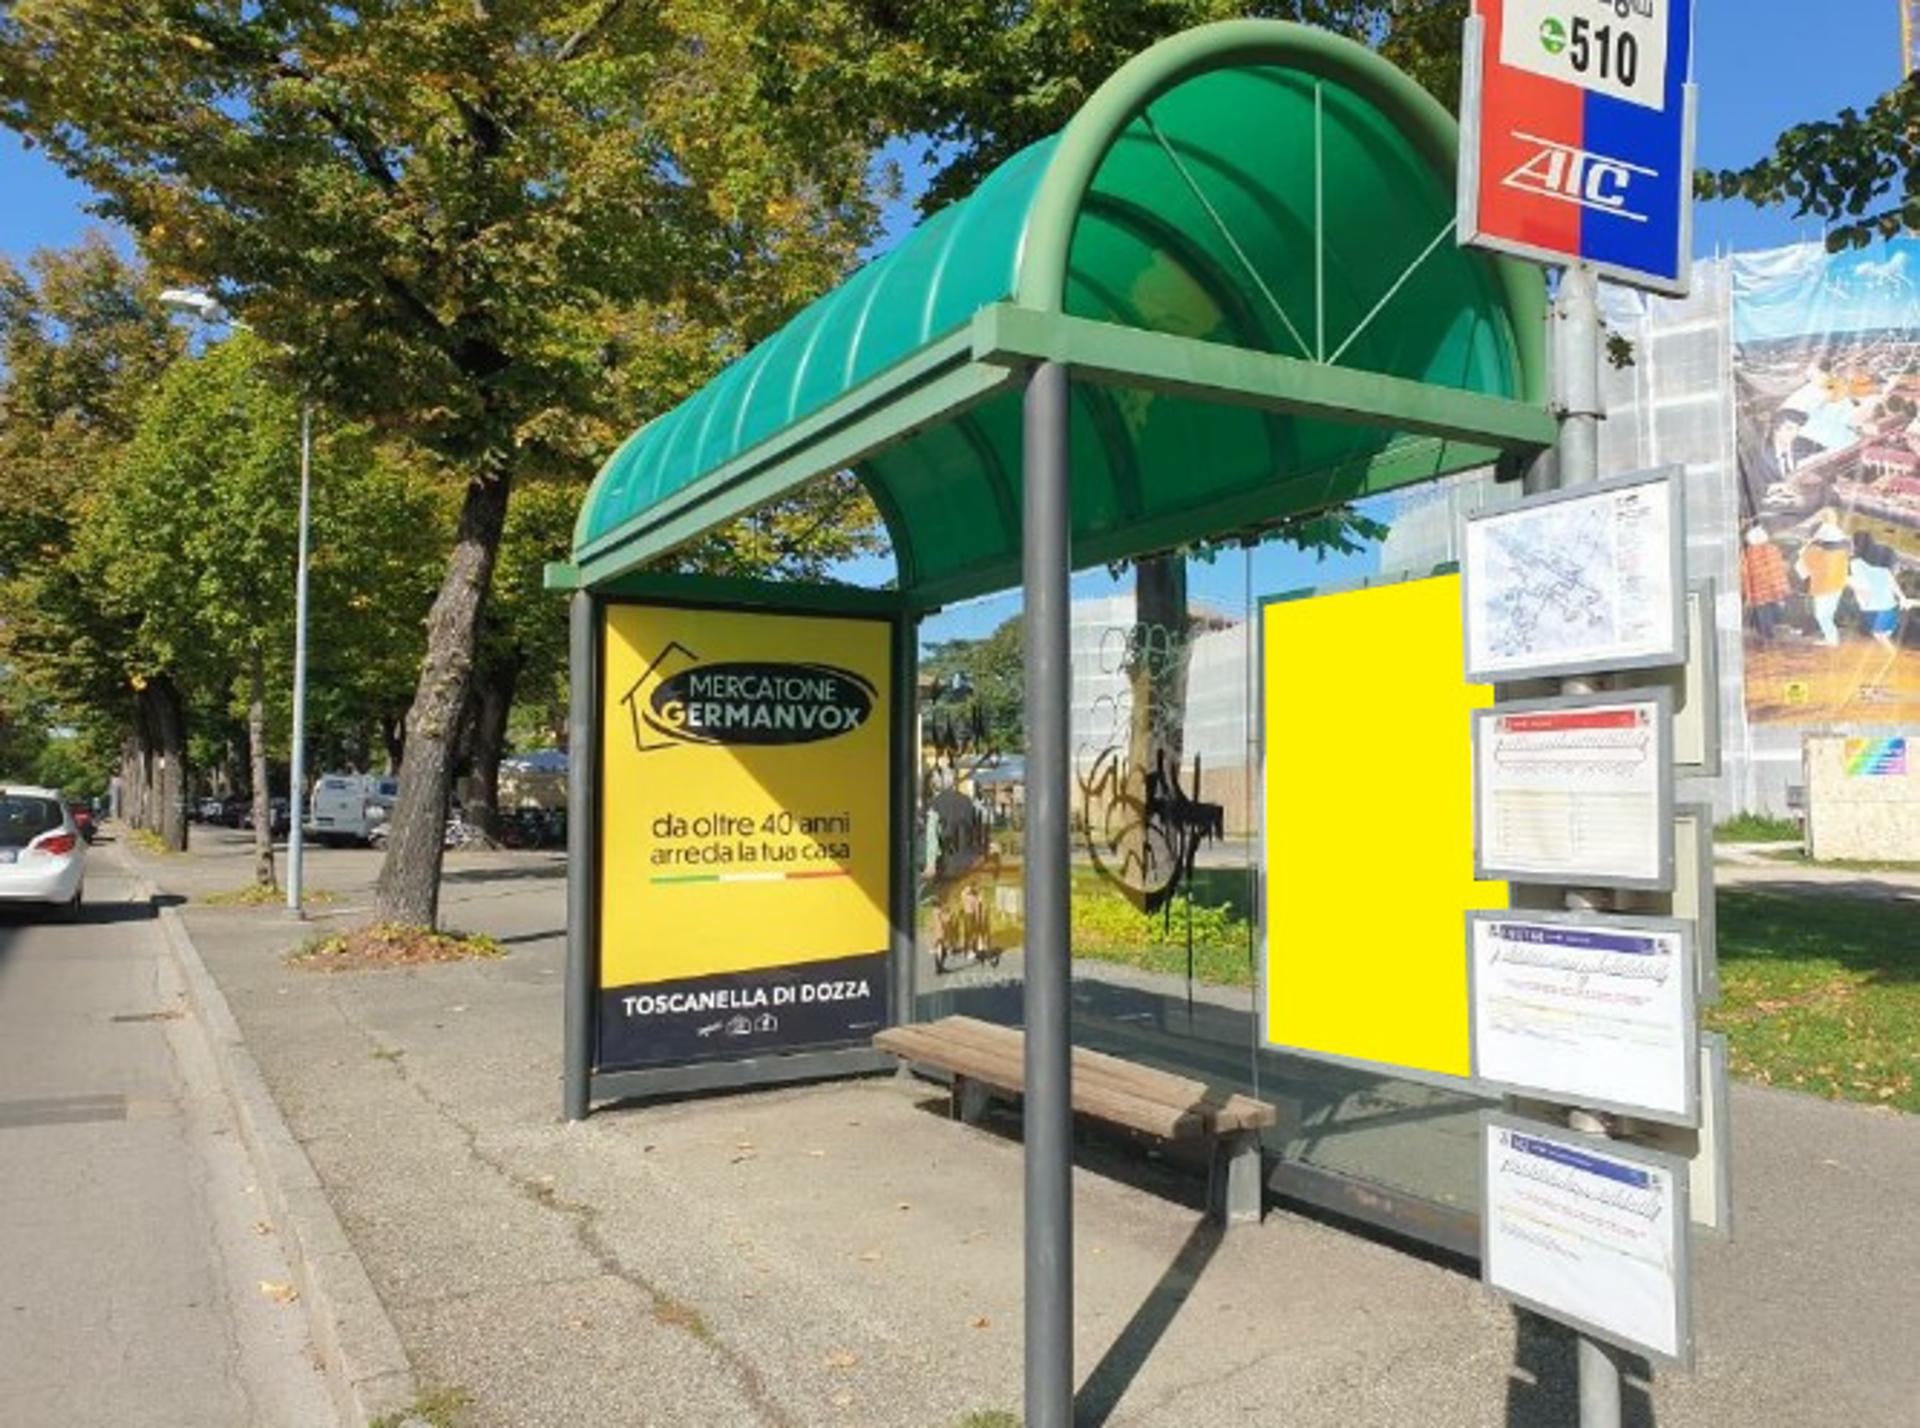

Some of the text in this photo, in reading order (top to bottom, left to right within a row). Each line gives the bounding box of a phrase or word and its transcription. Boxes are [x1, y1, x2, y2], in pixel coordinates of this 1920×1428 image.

[1570, 16, 1638, 88] 510
[1501, 142, 1638, 208] ATC
[689, 674, 836, 700] MERCATONE
[661, 700, 862, 729] GERMANVOX
[652, 811, 850, 838] da oltre 40 anni
[650, 841, 850, 865] arreda la tua casa
[622, 980, 870, 1017] TOSCANELLA DI DOZZA
